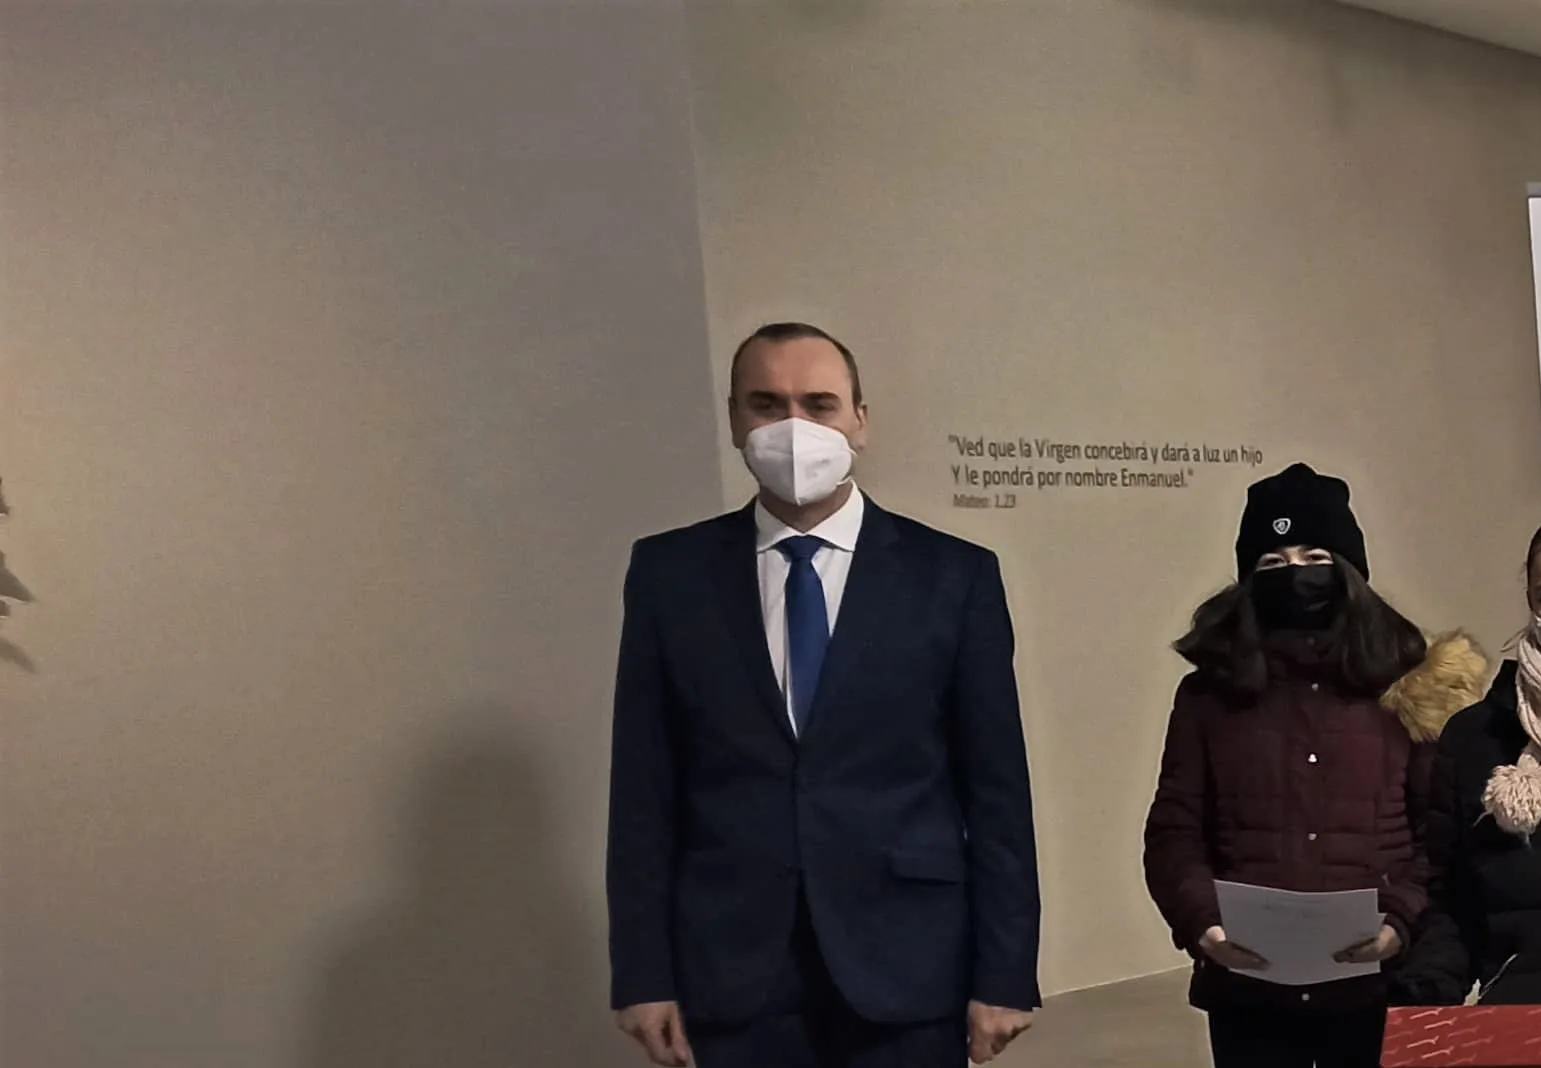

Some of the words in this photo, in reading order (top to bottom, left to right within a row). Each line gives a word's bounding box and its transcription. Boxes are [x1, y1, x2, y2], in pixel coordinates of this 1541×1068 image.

[949, 434, 984, 457] "Ved
[989, 440, 1017, 461] que
[1019, 437, 1032, 458] la
[1036, 438, 1081, 464] Virgen
[1084, 441, 1147, 461] concebirá
[1151, 447, 1159, 464] y
[1161, 443, 1190, 462] dará
[1193, 448, 1201, 462] a
[1203, 444, 1220, 463] luz
[1223, 449, 1238, 463] un
[1241, 445, 1262, 468] hijo
[952, 465, 961, 483] Y
[965, 466, 979, 485] le
[983, 466, 1033, 489] pondrá
[1037, 470, 1062, 489] por
[1065, 468, 1117, 487] nombre
[1121, 469, 1193, 488] Enmanuel."
